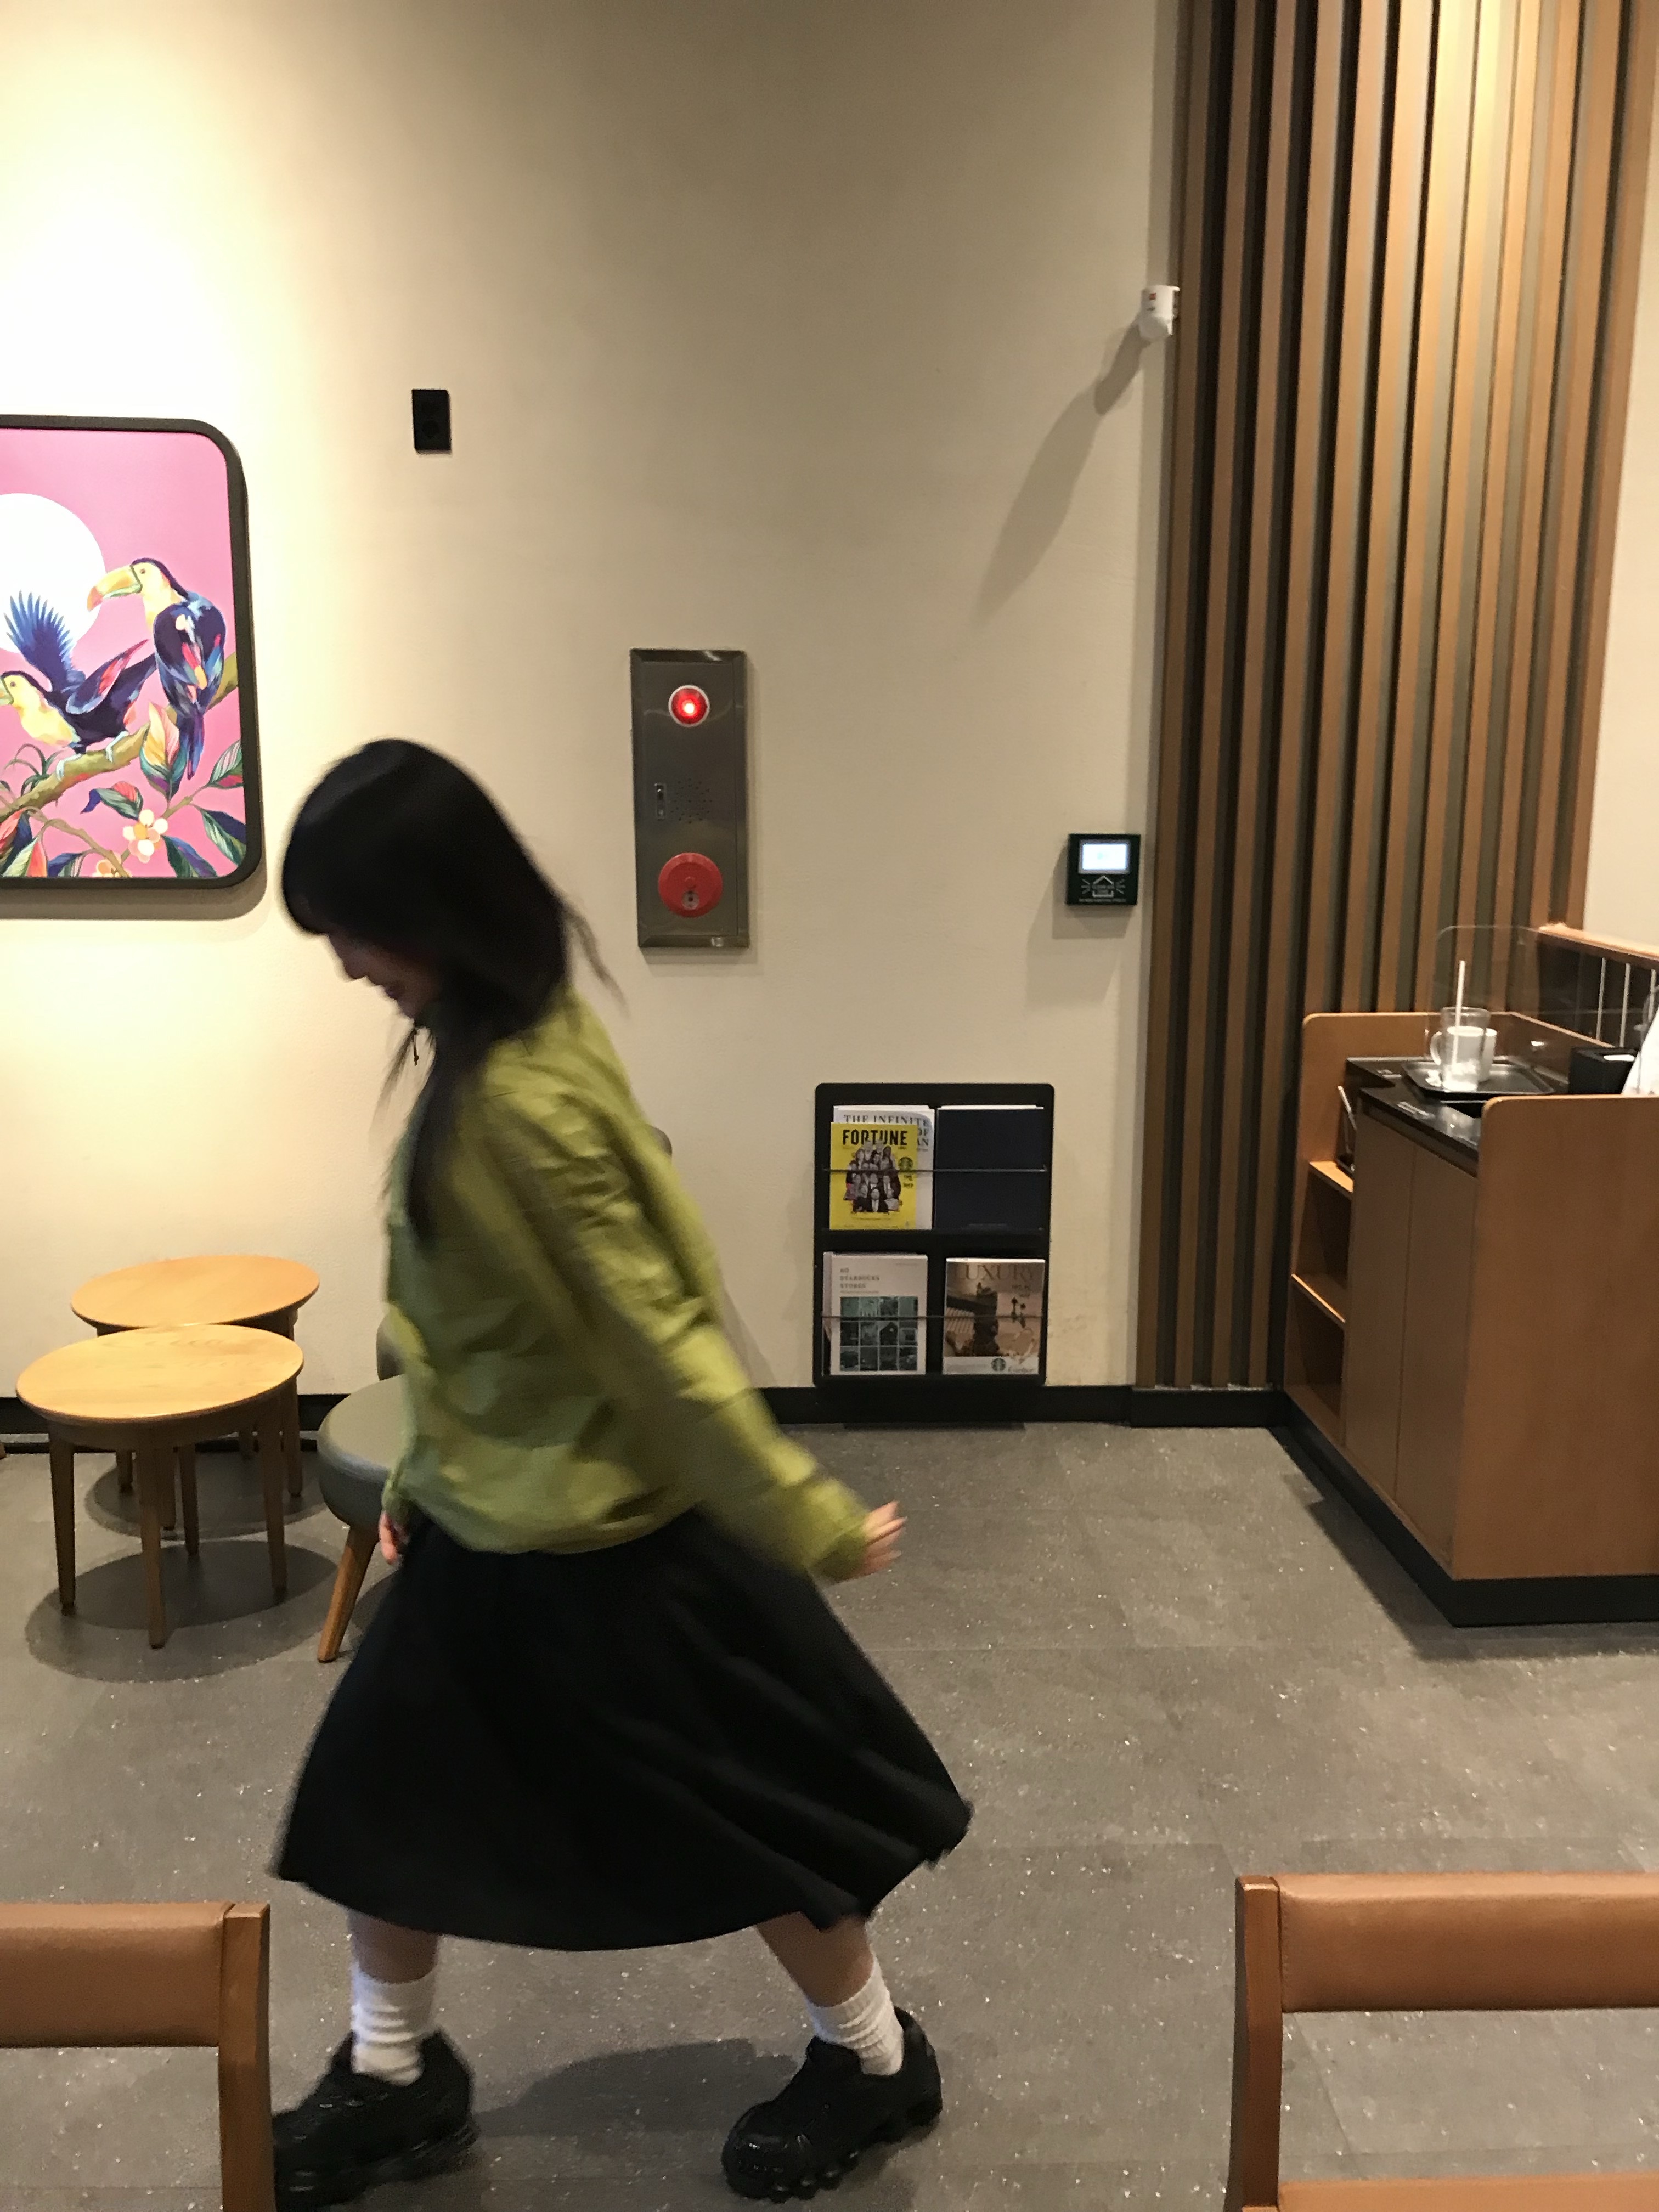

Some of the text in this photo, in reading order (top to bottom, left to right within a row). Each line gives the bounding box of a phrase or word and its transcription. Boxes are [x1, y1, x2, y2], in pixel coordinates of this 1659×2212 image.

[844, 1115, 930, 1126] THE INFINITE
[842, 1129, 907, 1146] FORTUNE
[952, 1264, 1039, 1283] LUXURY
